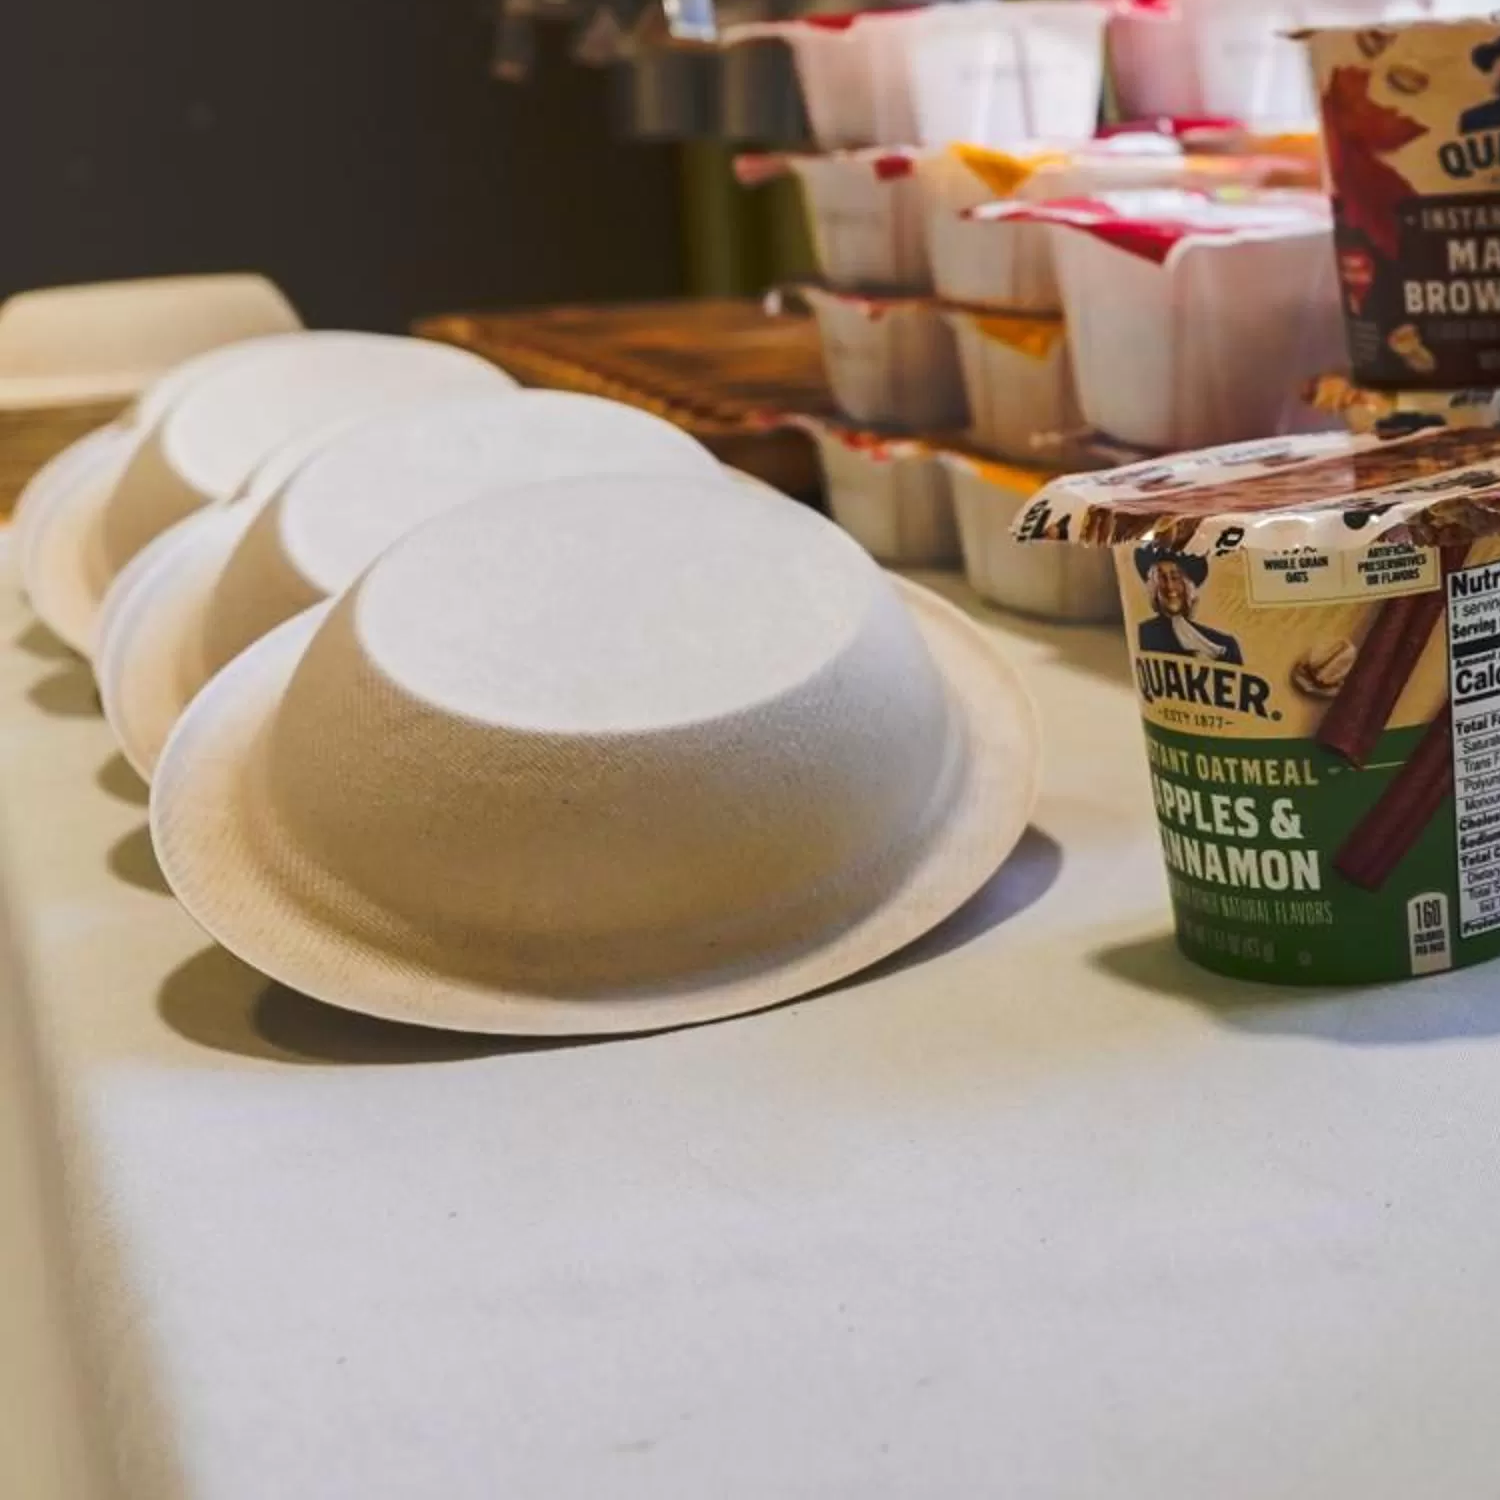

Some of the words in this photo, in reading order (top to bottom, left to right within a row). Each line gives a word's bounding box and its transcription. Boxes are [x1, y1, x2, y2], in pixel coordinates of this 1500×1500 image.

[1452, 617, 1497, 640] Serving
[1135, 657, 1270, 720] QUAKER
[1456, 711, 1489, 736] Total
[1195, 753, 1319, 786] OATMEAL
[1270, 798, 1304, 839] &
[1414, 899, 1442, 931] 160
